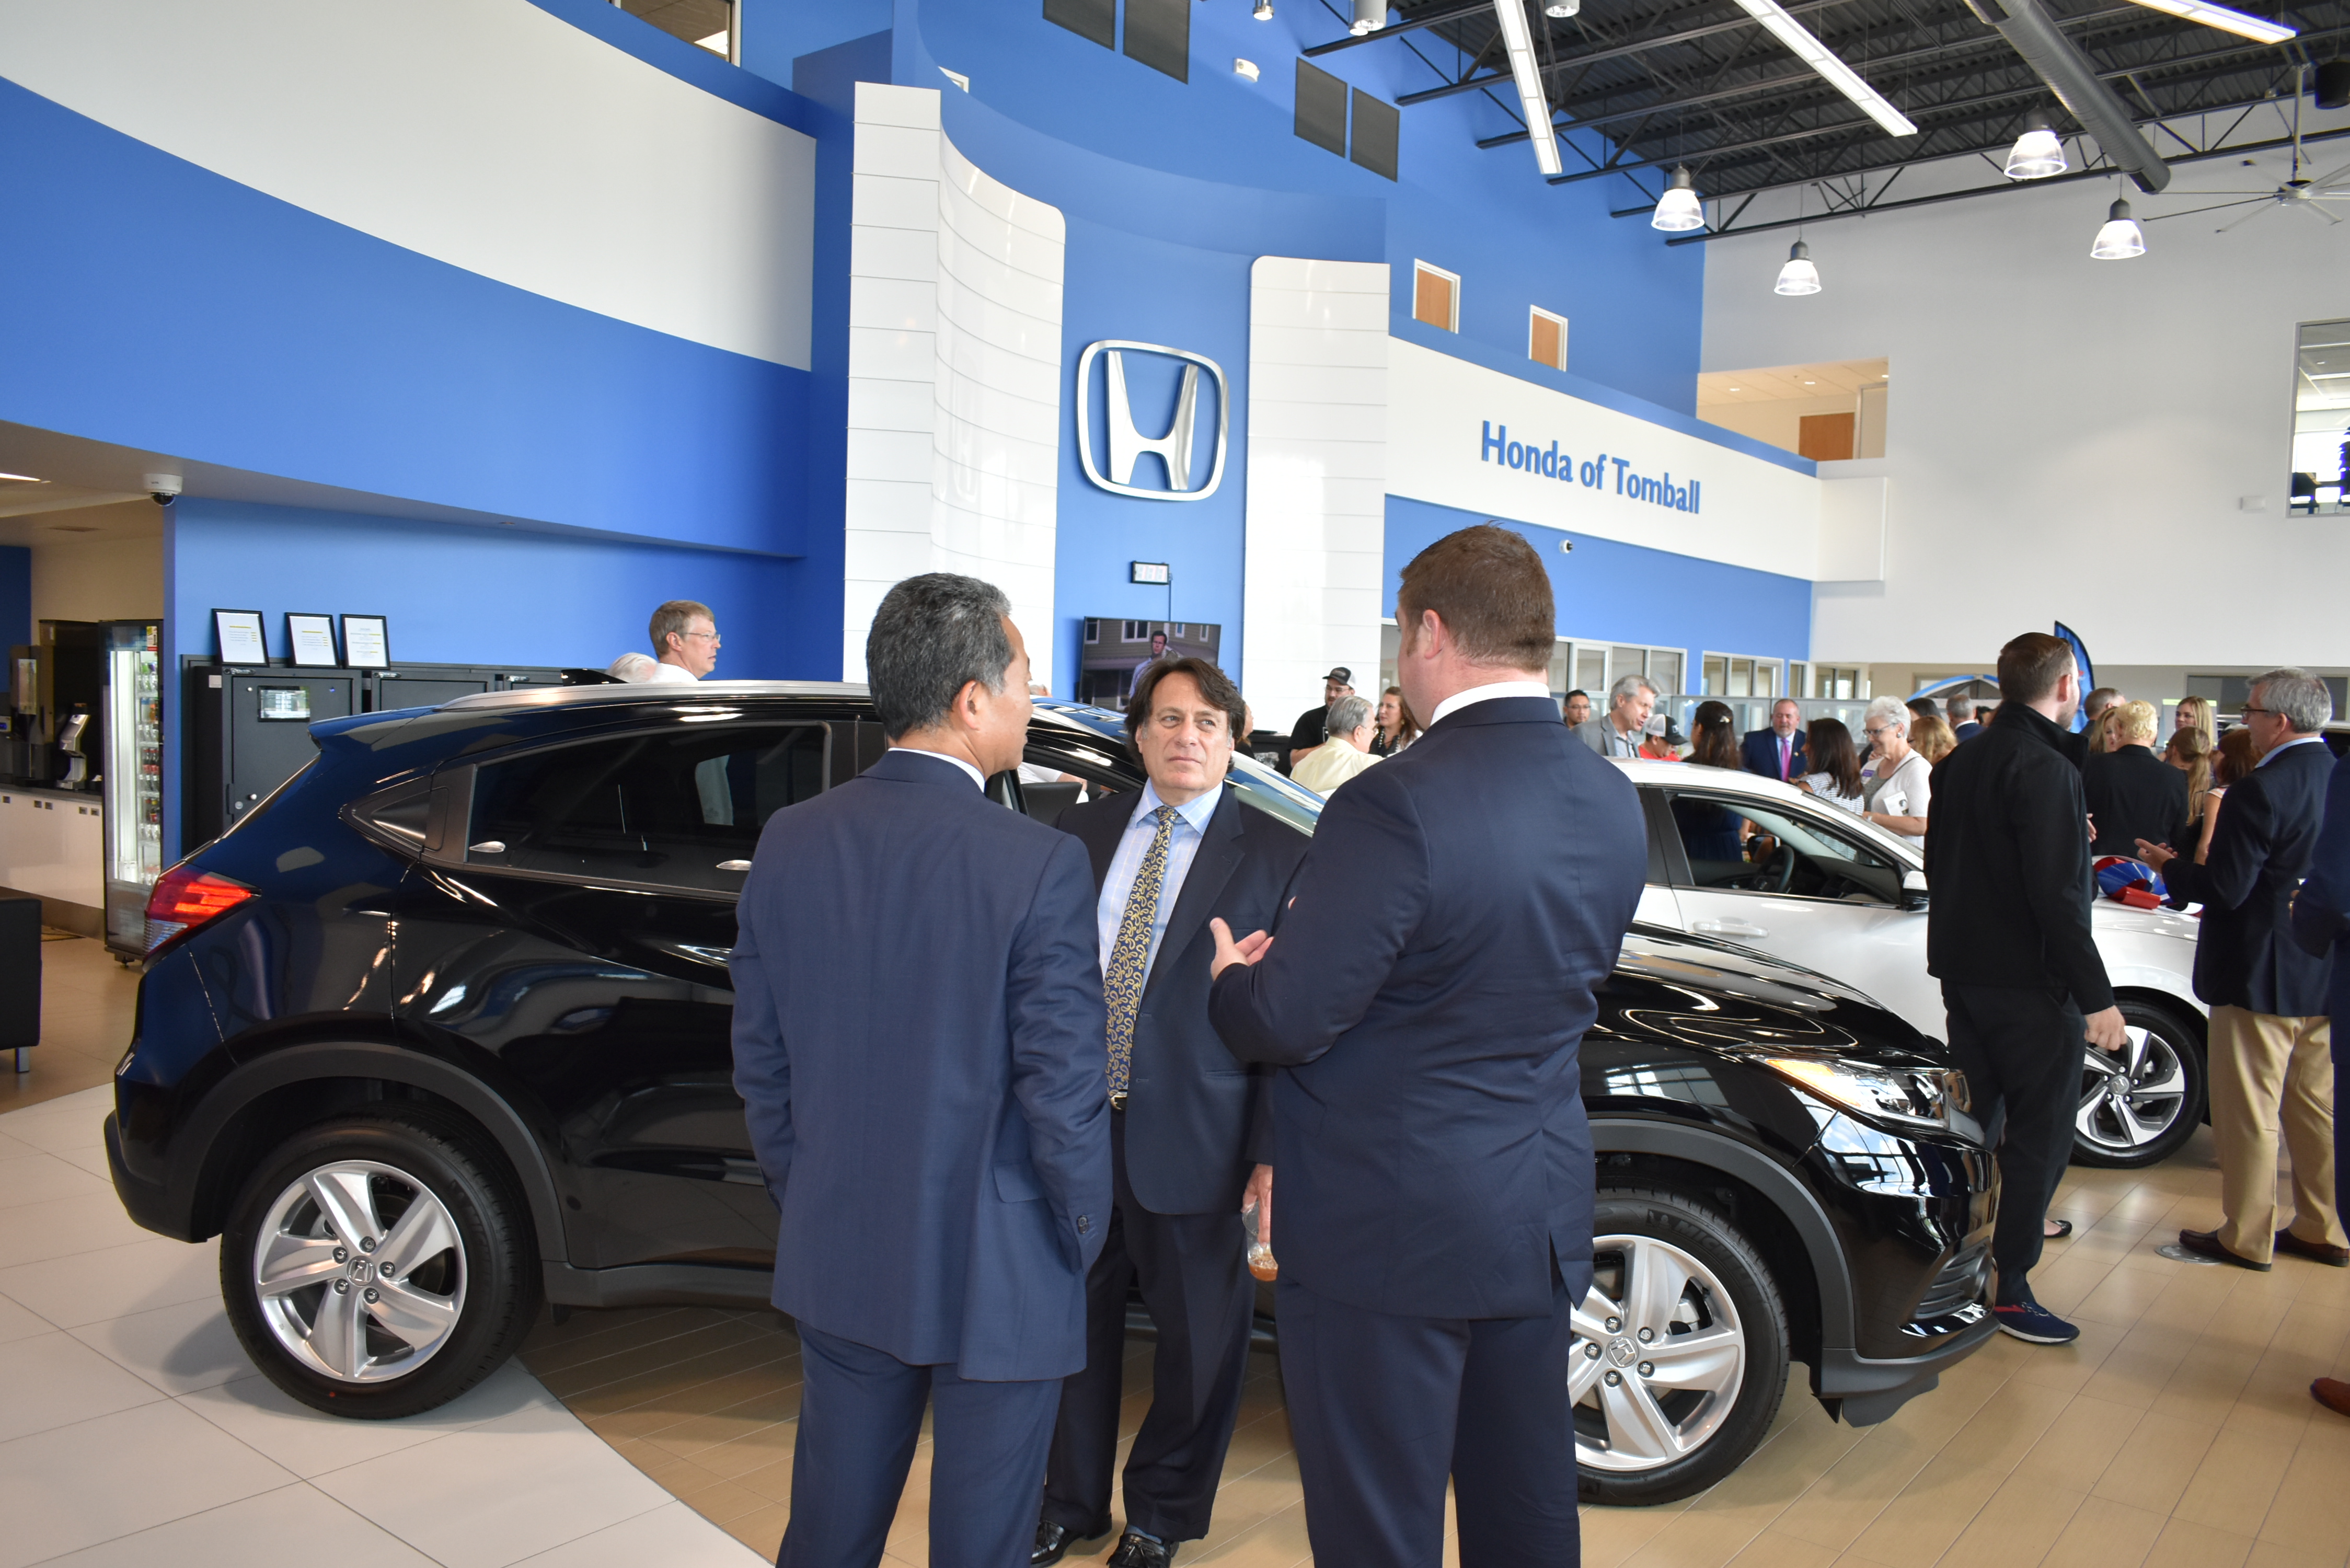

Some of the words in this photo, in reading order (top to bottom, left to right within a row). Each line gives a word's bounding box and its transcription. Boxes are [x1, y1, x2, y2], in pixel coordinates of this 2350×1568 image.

[1482, 420, 1573, 482] Honda
[1581, 454, 1607, 489] of
[1612, 457, 1700, 514] Tomball
